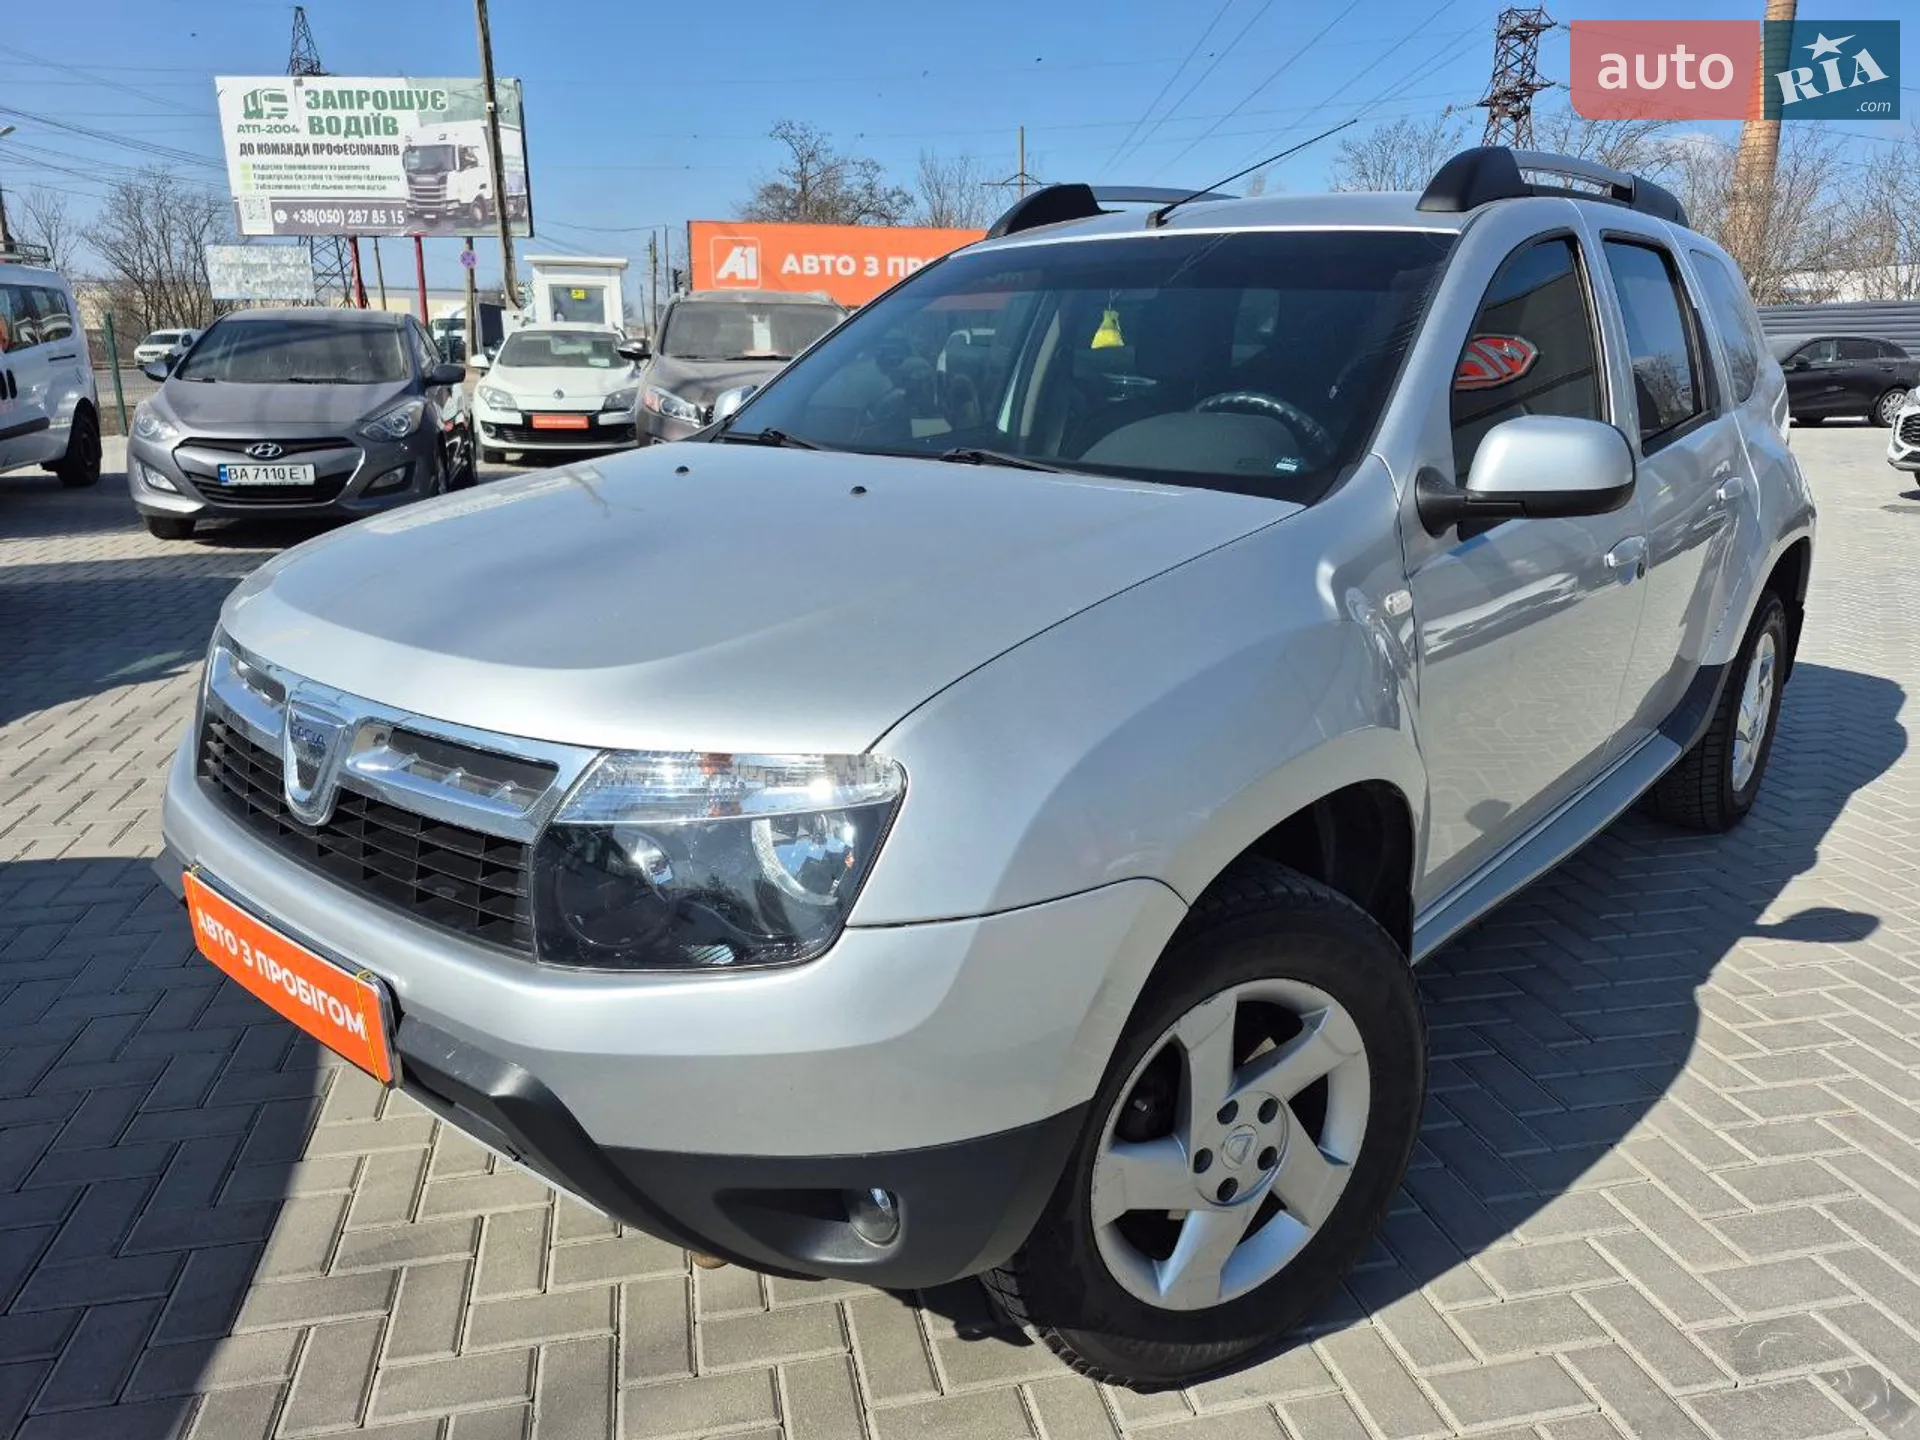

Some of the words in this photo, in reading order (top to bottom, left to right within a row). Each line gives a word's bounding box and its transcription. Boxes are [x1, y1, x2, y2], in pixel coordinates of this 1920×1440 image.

[304, 88, 448, 111] ЗАПРОШУЄ
[237, 124, 300, 134] АТП-2004
[308, 112, 399, 139] ВОДІЇВ
[239, 142, 255, 157] ДО
[257, 143, 311, 157] КОМАНДИ
[312, 143, 400, 157] ПРОФЕСІОНАЛІВ
[292, 208, 345, 227] +38(050)
[347, 209, 368, 224] 287
[372, 209, 387, 224] 85
[390, 209, 405, 225] 15
[781, 253, 857, 277] АВТО
[887, 255, 937, 280] ПР
[228, 467, 249, 480] BA
[252, 467, 286, 480] 7110
[289, 467, 307, 480] EI
[197, 907, 238, 955] АВТО
[255, 949, 367, 1041] ПРОБІГОМ
